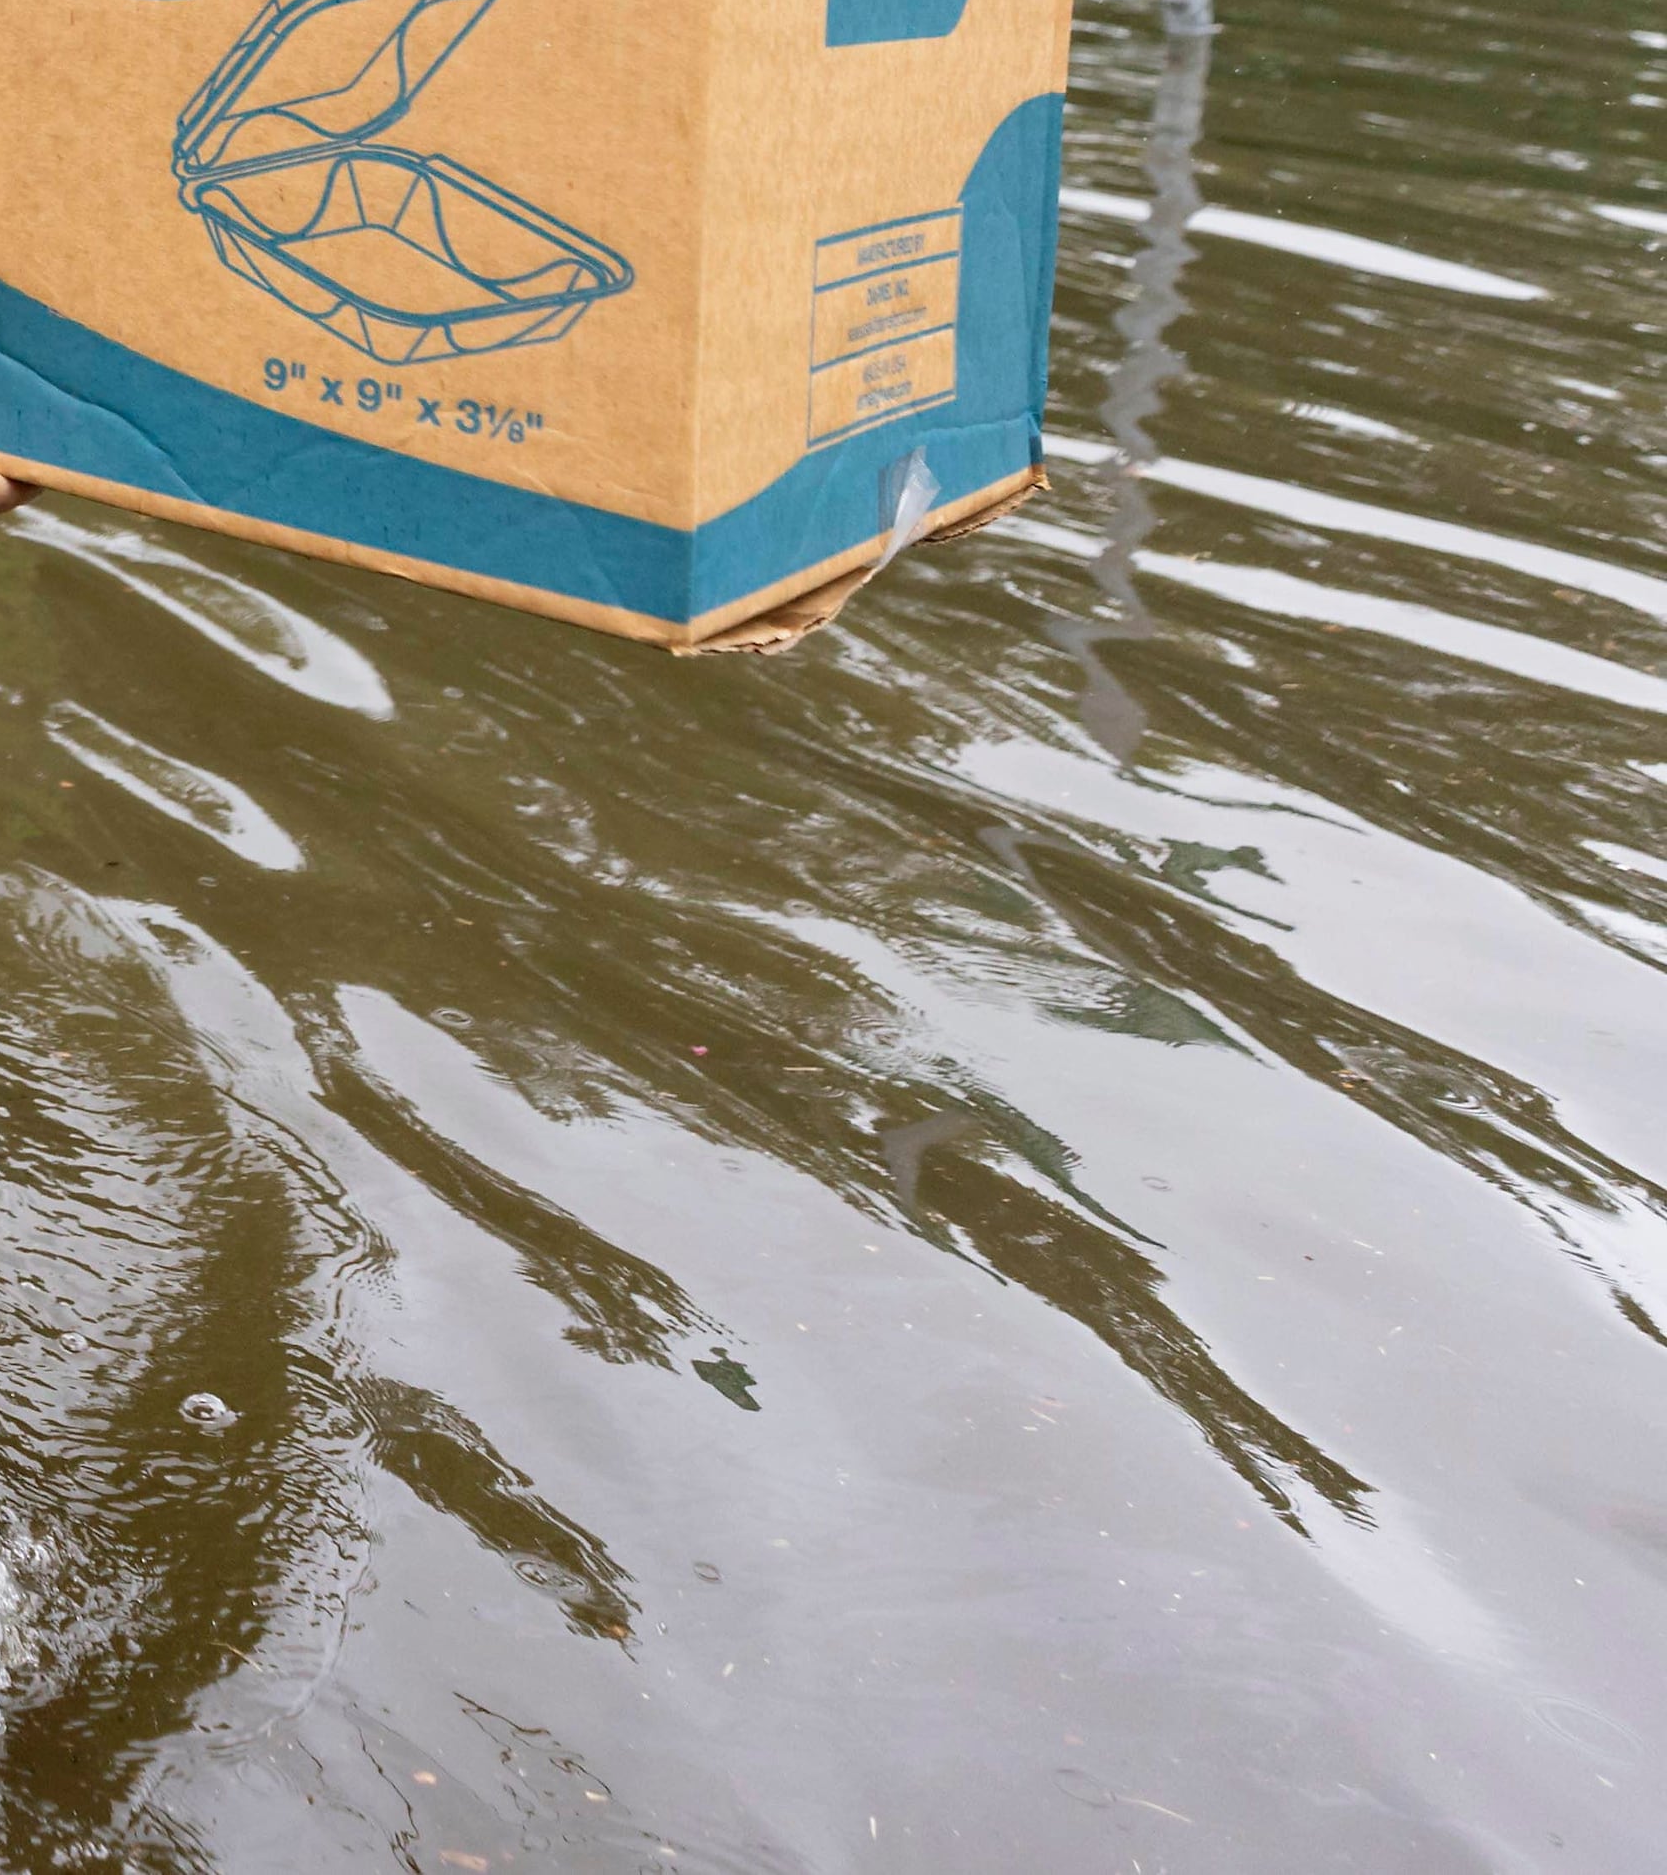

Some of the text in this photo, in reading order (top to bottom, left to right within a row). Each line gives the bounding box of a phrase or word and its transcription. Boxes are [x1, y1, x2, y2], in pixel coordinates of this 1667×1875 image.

[263, 357, 306, 391] 9"
[320, 377, 344, 405] x
[357, 378, 402, 412] 9"
[417, 398, 442, 426] x
